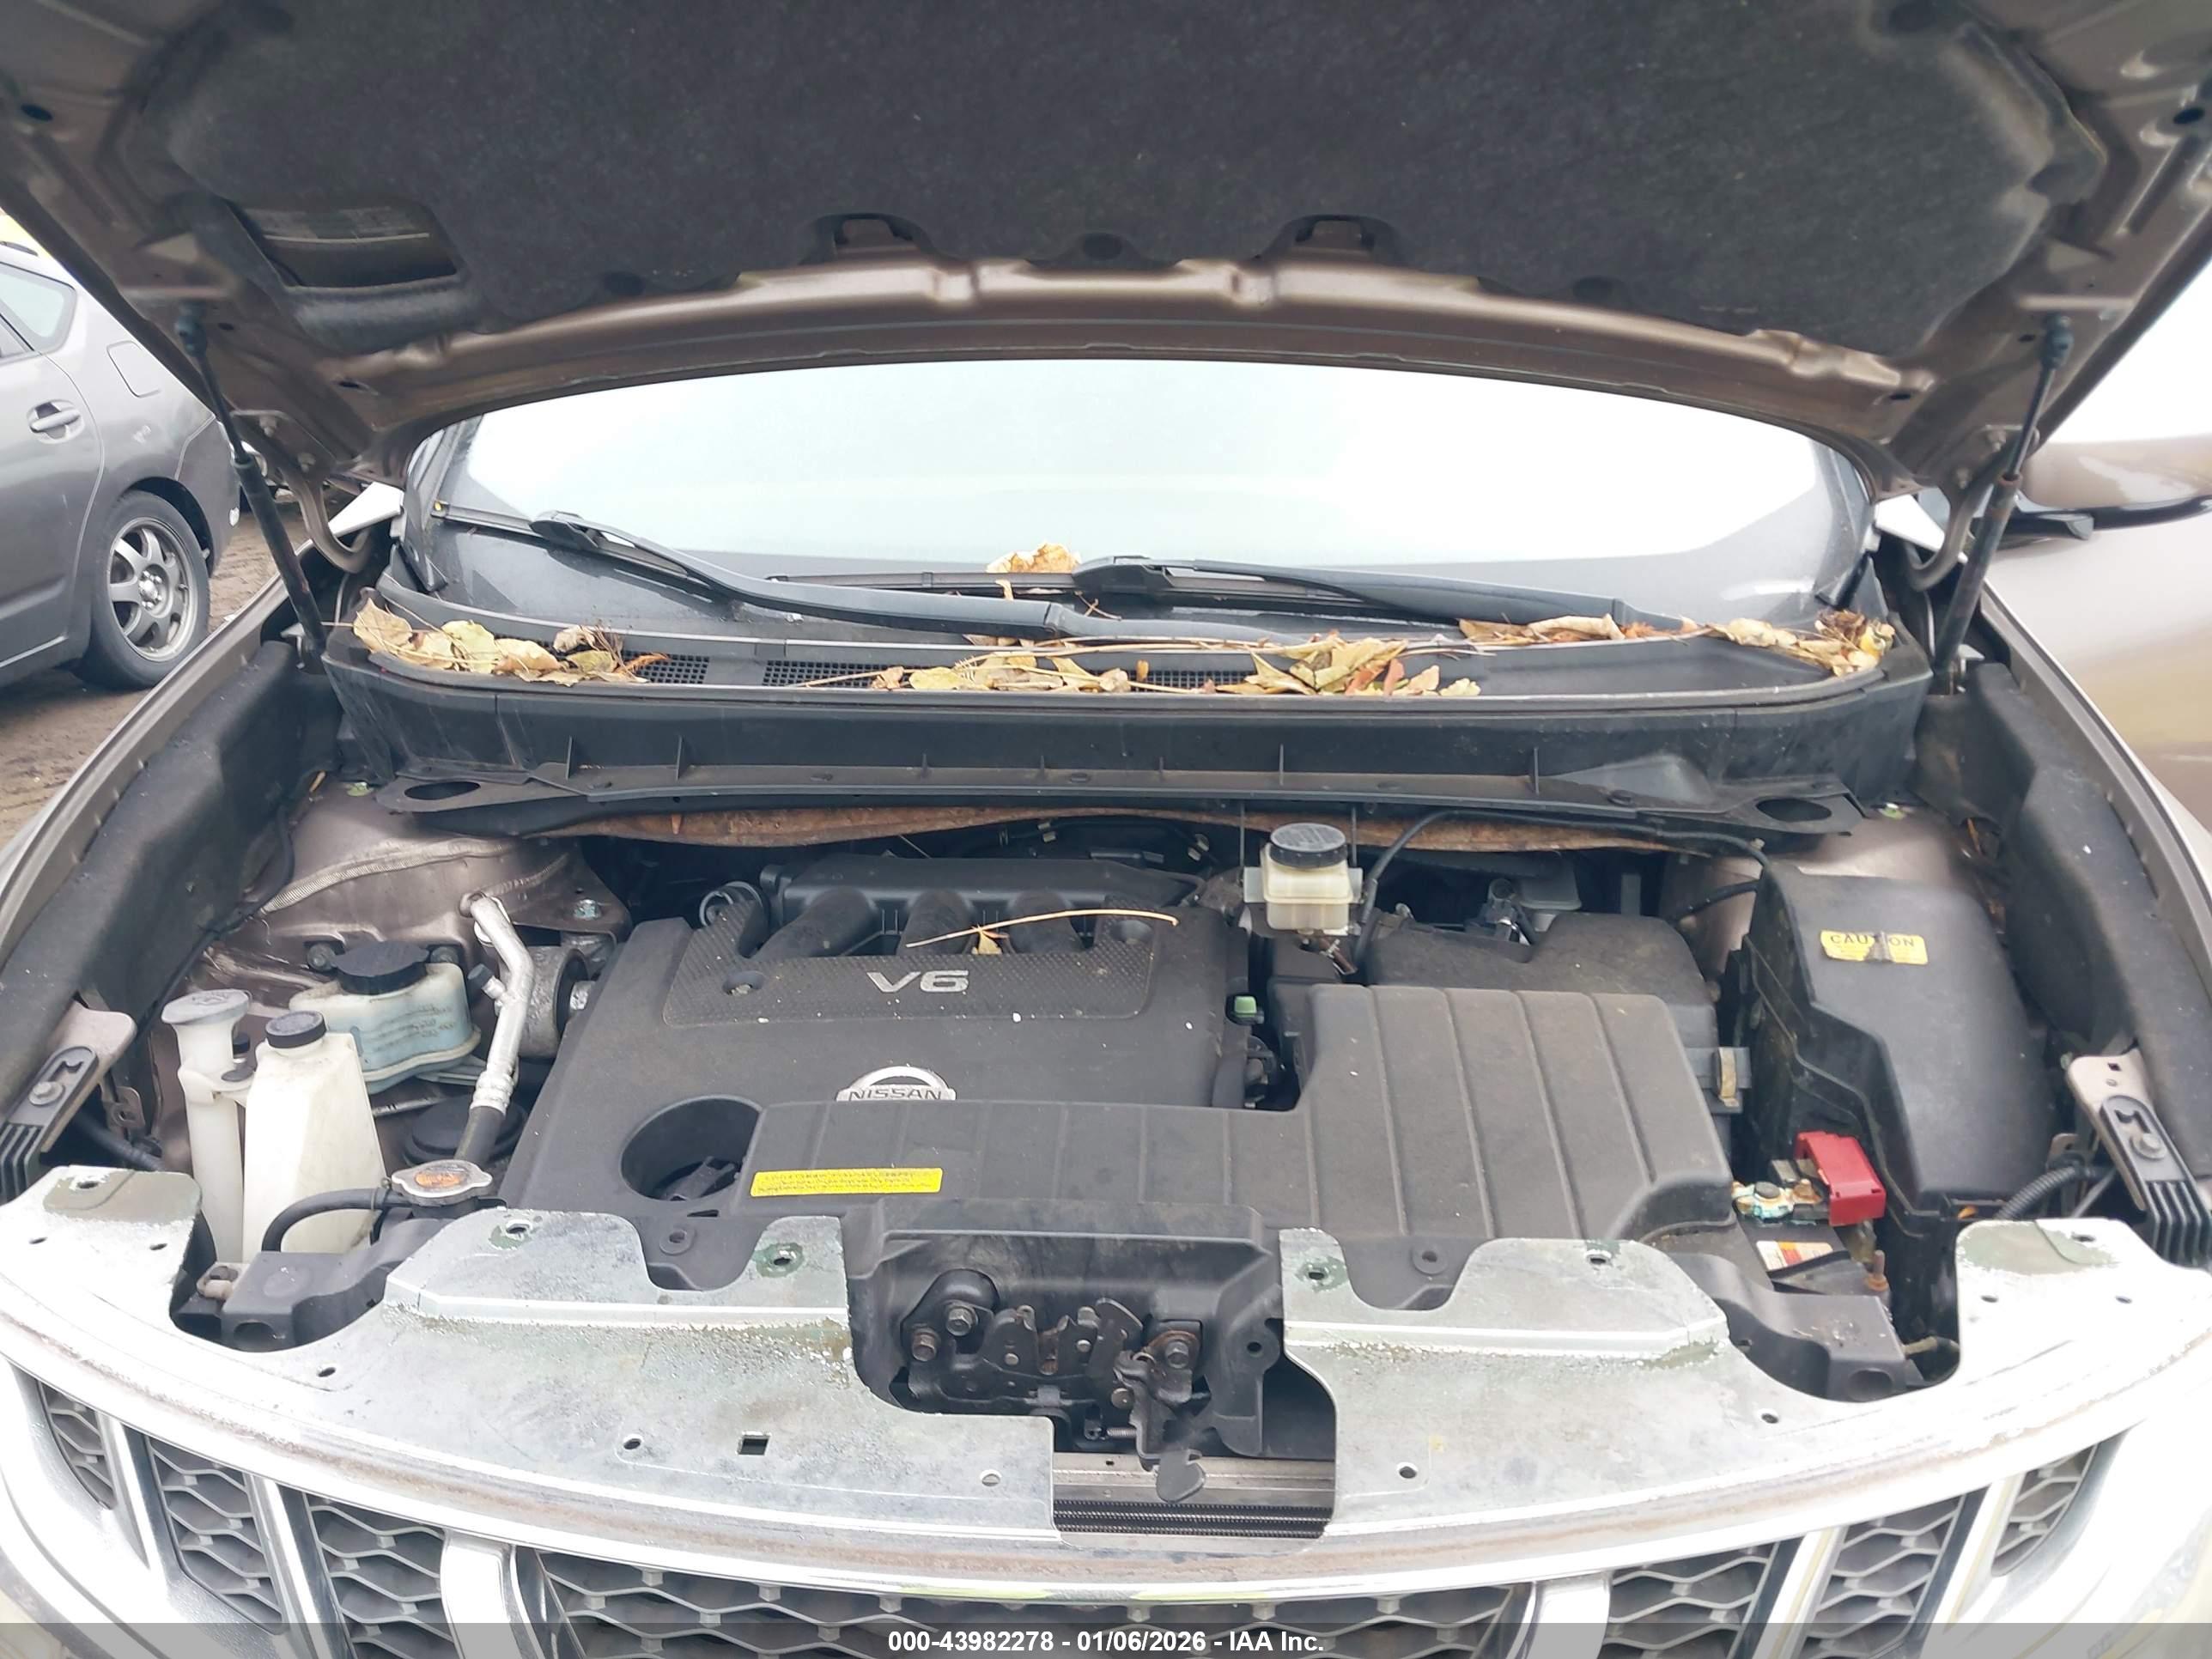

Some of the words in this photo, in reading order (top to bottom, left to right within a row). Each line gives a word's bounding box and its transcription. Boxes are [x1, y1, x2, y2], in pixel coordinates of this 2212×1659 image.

[1830, 933, 1915, 947] CAUON
[866, 969, 969, 993] V6
[848, 1088, 942, 1101] NISSAN
